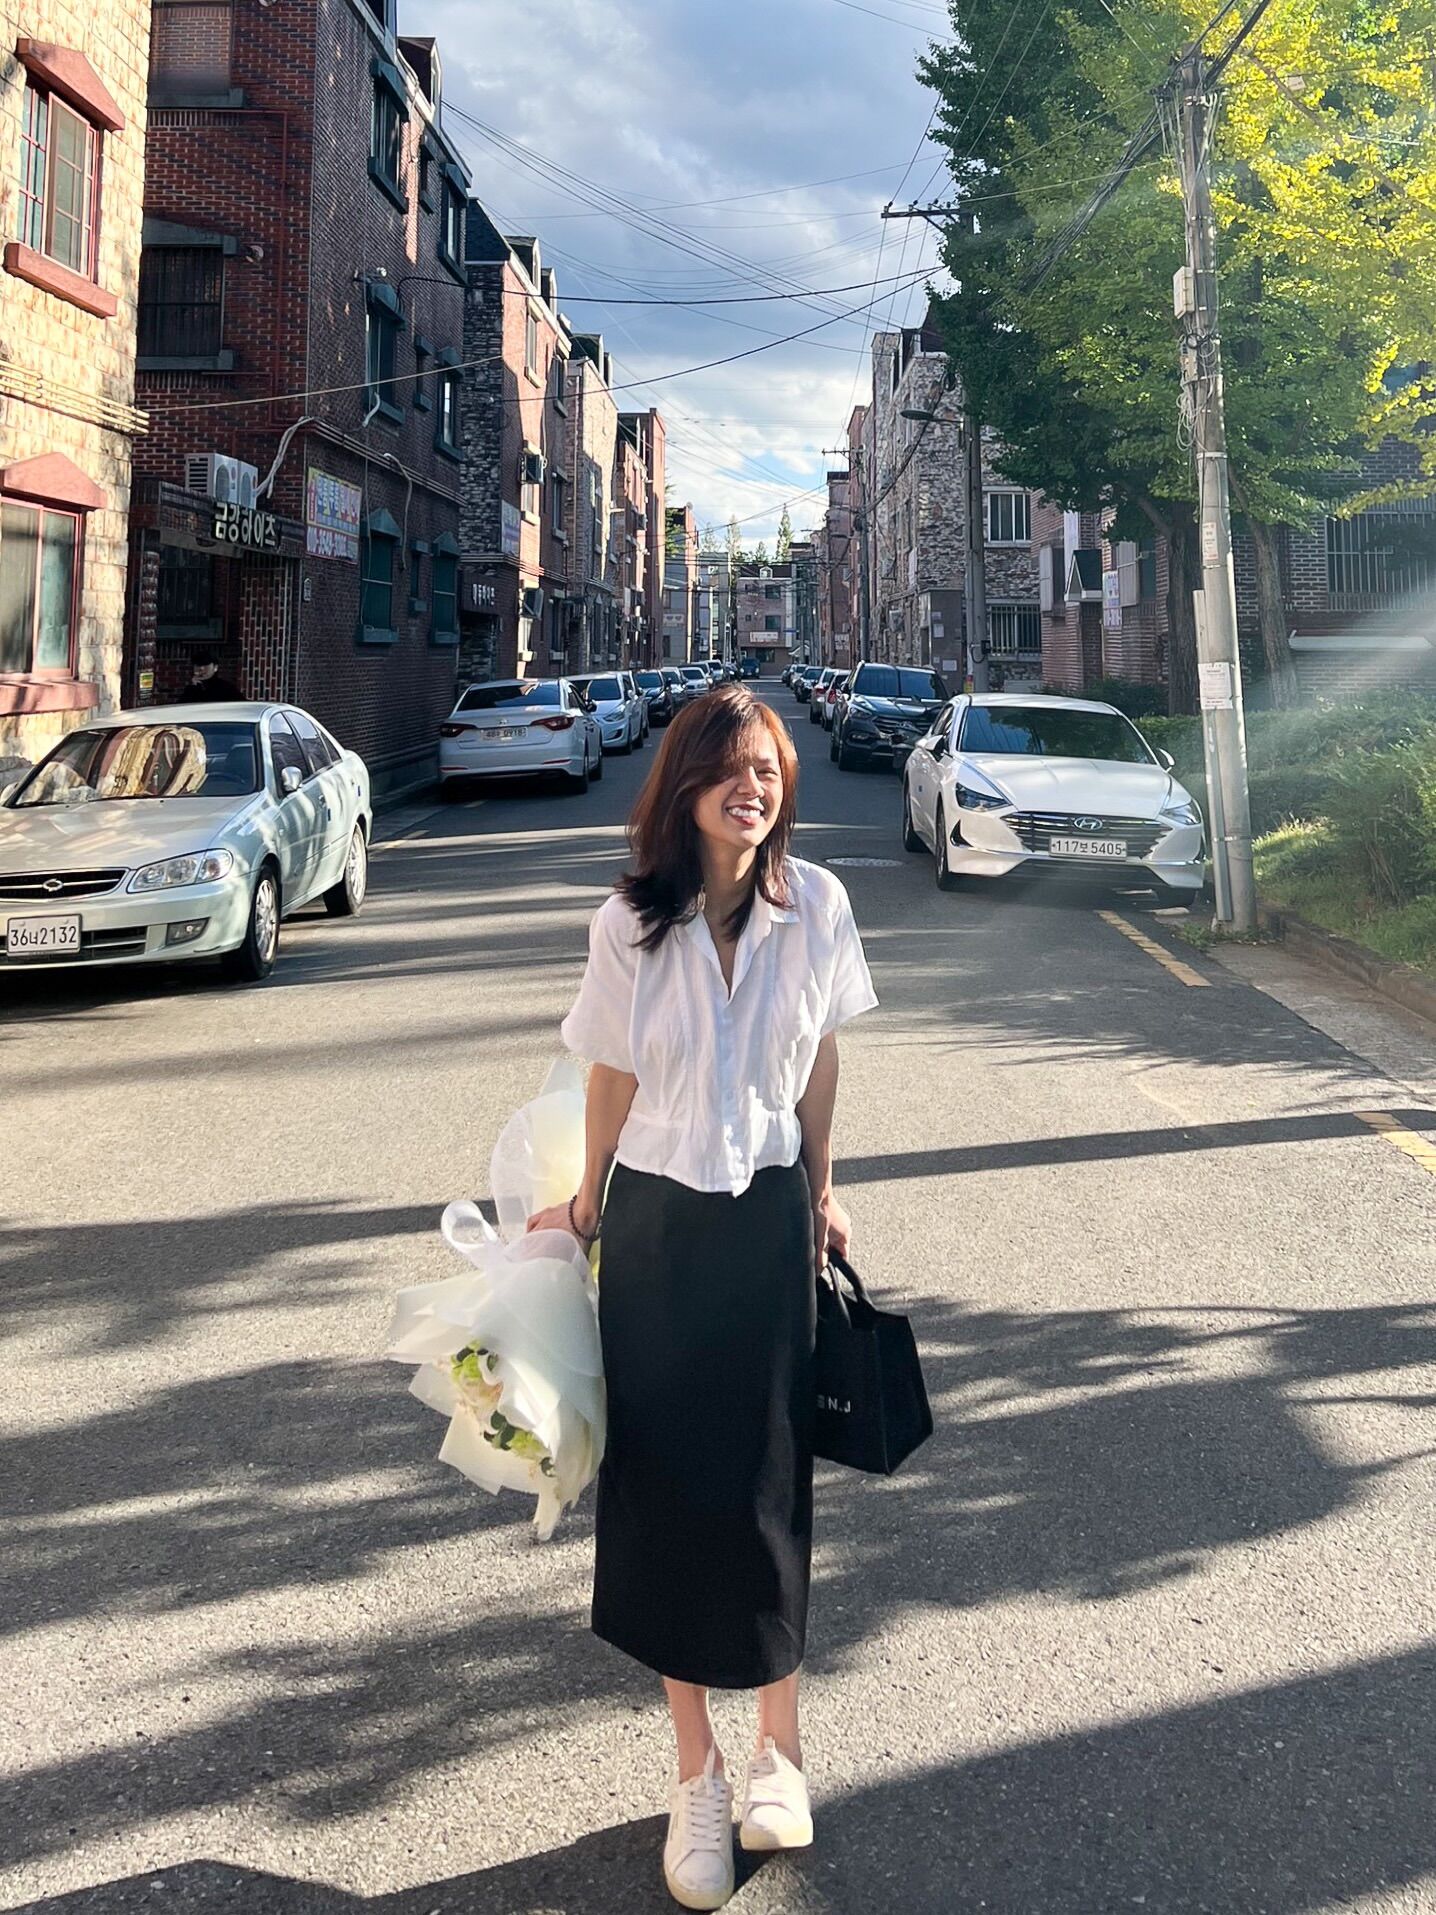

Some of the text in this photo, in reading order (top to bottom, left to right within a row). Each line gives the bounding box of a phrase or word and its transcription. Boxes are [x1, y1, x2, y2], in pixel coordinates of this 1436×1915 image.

[215, 502, 275, 547] 금강하이츠
[1091, 842, 1122, 855] 5405
[10, 926, 77, 946] 36너2132
